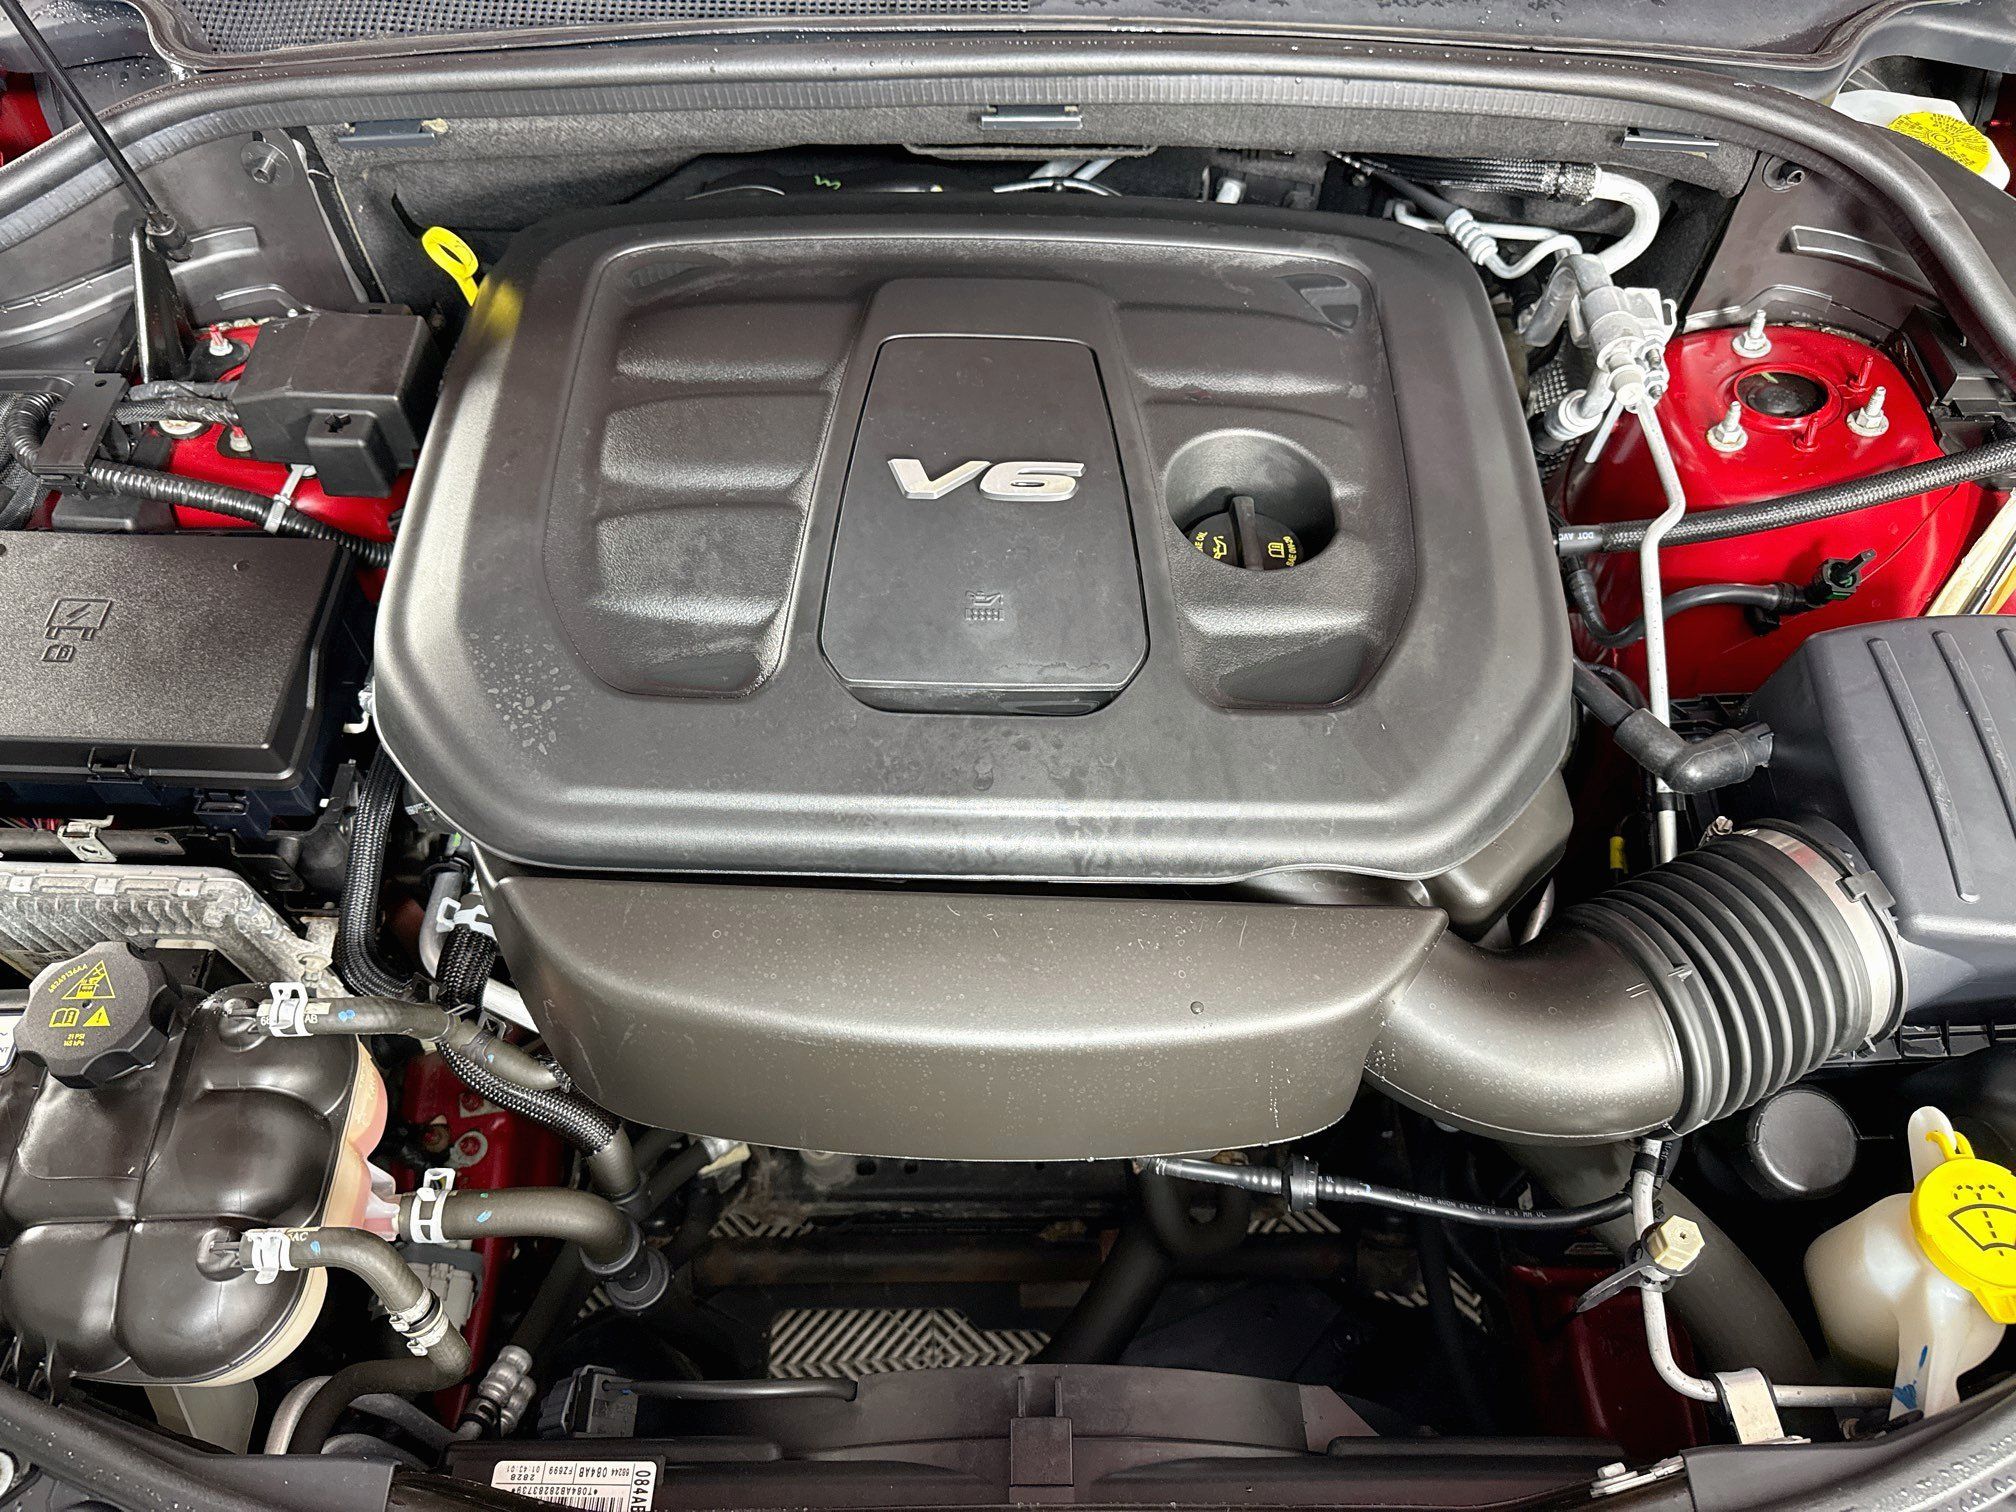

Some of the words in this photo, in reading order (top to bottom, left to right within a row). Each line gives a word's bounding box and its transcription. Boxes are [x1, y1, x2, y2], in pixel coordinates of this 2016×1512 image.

[887, 458, 1087, 503] V6
[1196, 531, 1208, 542] OIL
[1577, 532, 1594, 540] DOT
[1286, 554, 1297, 567] SAE
[1419, 1195, 1433, 1203] DOT
[510, 1473, 535, 1481] 2828
[579, 1467, 608, 1478] 084AB
